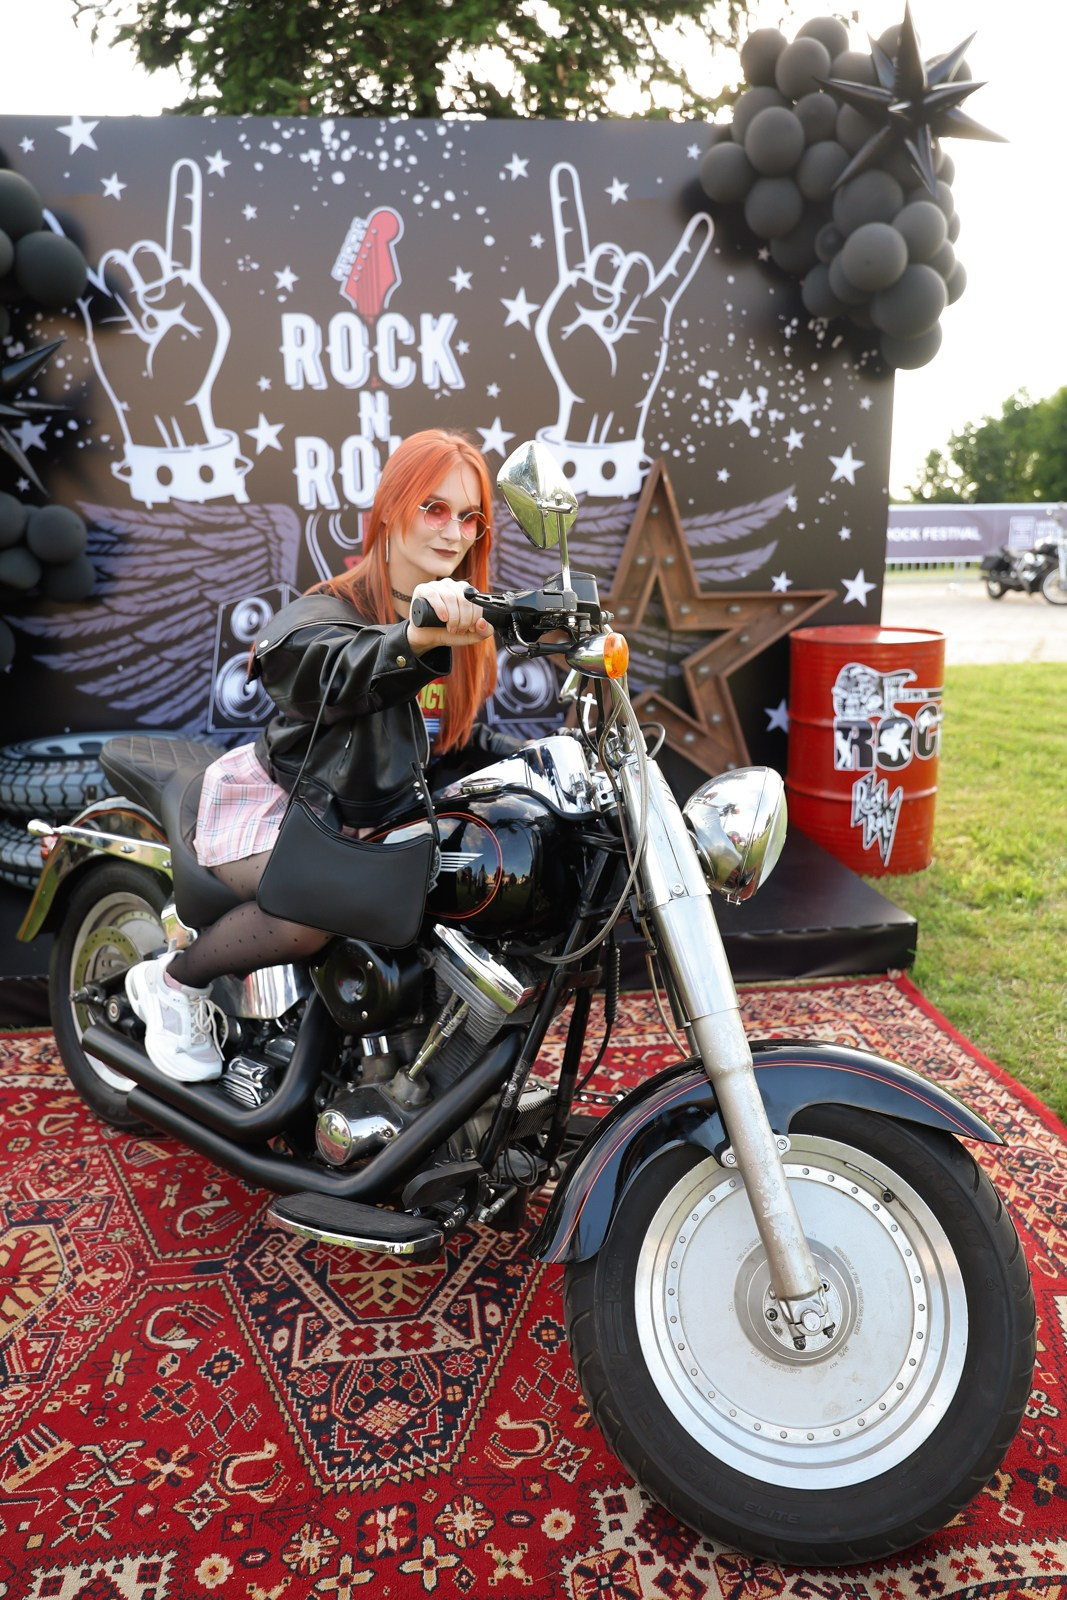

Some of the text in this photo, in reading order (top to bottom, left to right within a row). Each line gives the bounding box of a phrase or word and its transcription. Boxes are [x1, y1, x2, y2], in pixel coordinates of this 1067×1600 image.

[280, 311, 466, 390] ROCK
[357, 390, 392, 441] N
[293, 434, 402, 510] RO
[922, 526, 982, 541] FESTIVAL
[834, 703, 942, 770] ROC
[743, 1500, 801, 1524] ELITE
